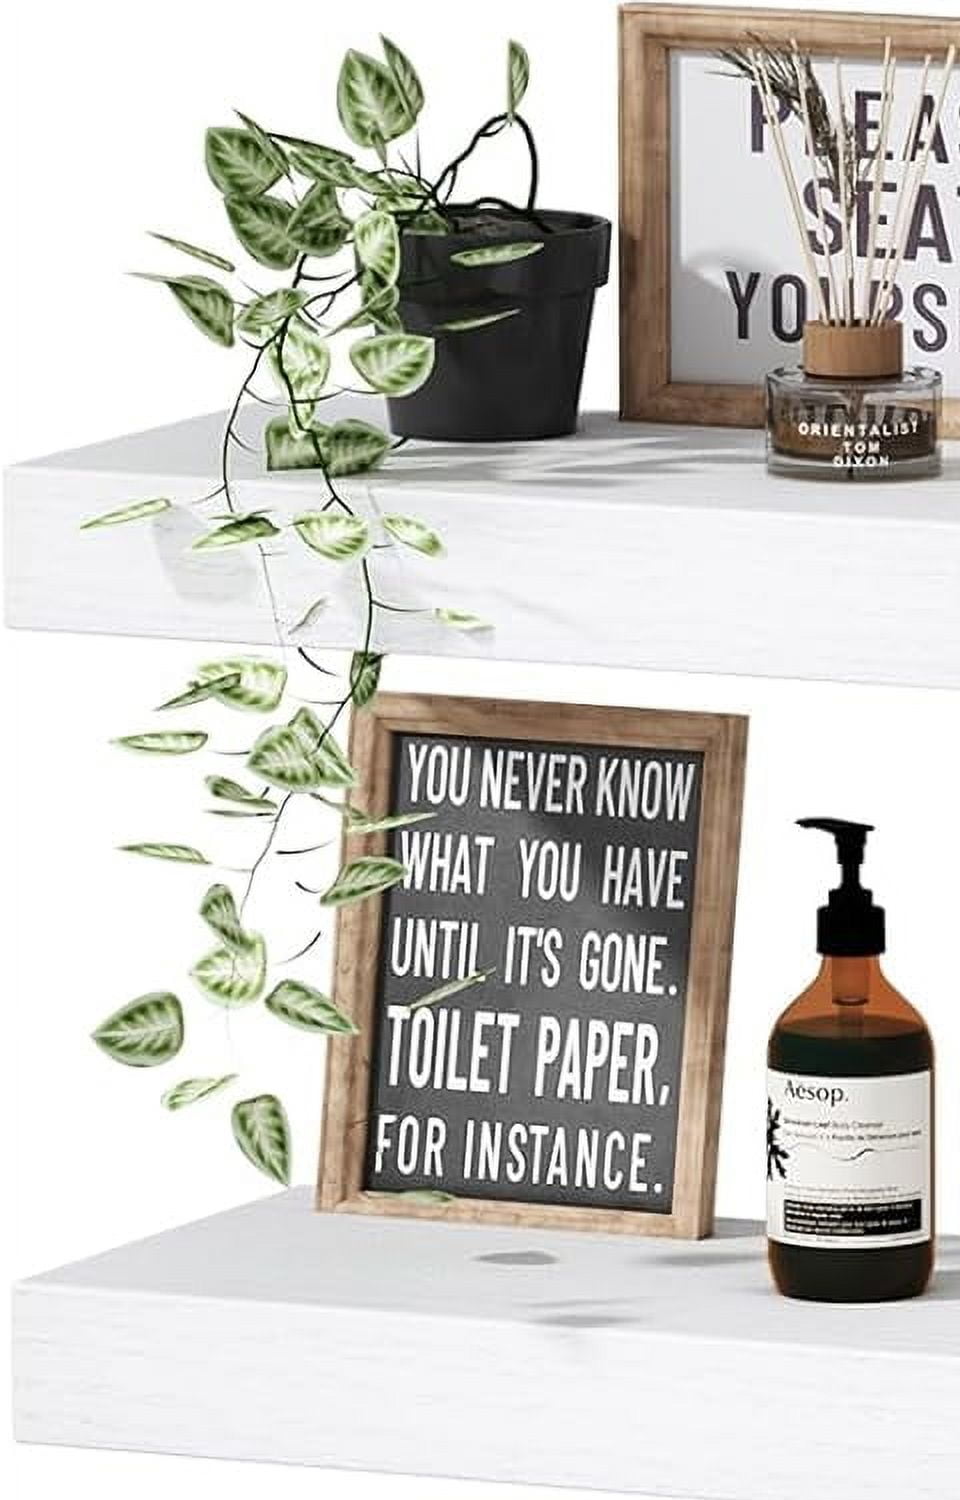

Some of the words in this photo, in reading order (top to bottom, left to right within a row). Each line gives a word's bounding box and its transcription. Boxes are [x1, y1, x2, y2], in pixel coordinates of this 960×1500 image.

[798, 418, 918, 437] ORIENTALIST
[843, 440, 881, 454] TOM
[408, 743, 473, 806] YOU
[479, 749, 589, 817] NEVER
[595, 756, 697, 823] KNOW
[400, 830, 496, 895] WHAT
[519, 838, 582, 902] YOU
[601, 845, 689, 909] HAVE
[391, 916, 487, 981] UNTIL
[504, 925, 564, 989] IT'S
[579, 930, 678, 997] GONE.
[386, 1004, 520, 1094] TOILET
[534, 1015, 671, 1106] PAPER,
[374, 1112, 447, 1177] FOR
[463, 1118, 663, 1195] INSTANCE.
